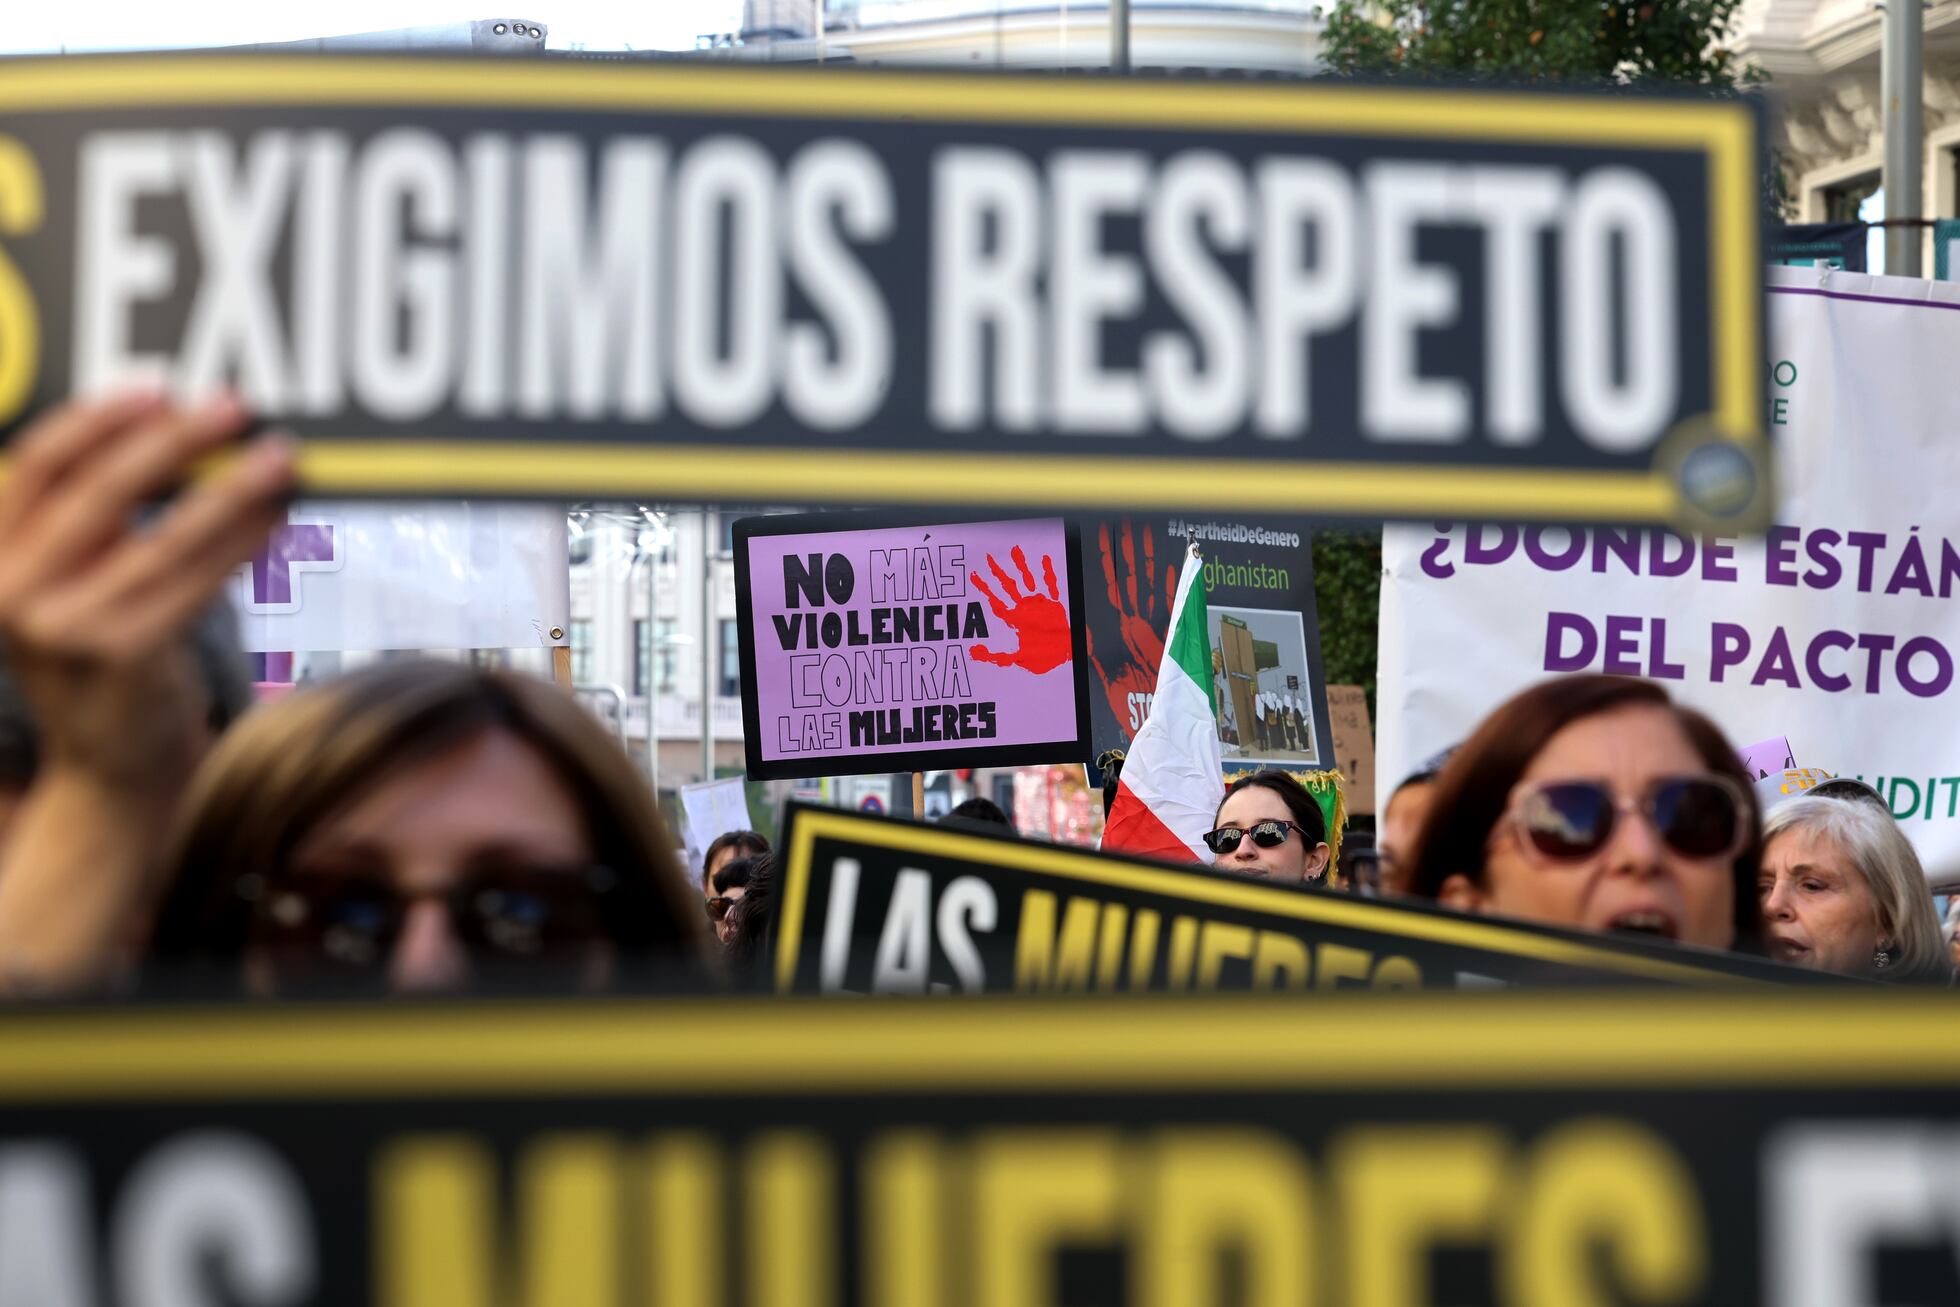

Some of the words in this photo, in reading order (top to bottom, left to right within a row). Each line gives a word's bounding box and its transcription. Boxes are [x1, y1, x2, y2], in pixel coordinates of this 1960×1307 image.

[73, 127, 897, 430] EXIGIMOS
[929, 143, 1680, 454] RESPETO
[782, 552, 855, 609] NO
[869, 533, 966, 603] MÁS
[771, 601, 989, 651] VIOLENCIA
[1543, 611, 1686, 681] DEL
[1709, 621, 1954, 699] PACTO
[789, 644, 973, 709] CONTRA
[778, 711, 843, 753] LAS
[849, 701, 997, 748] MUJERES
